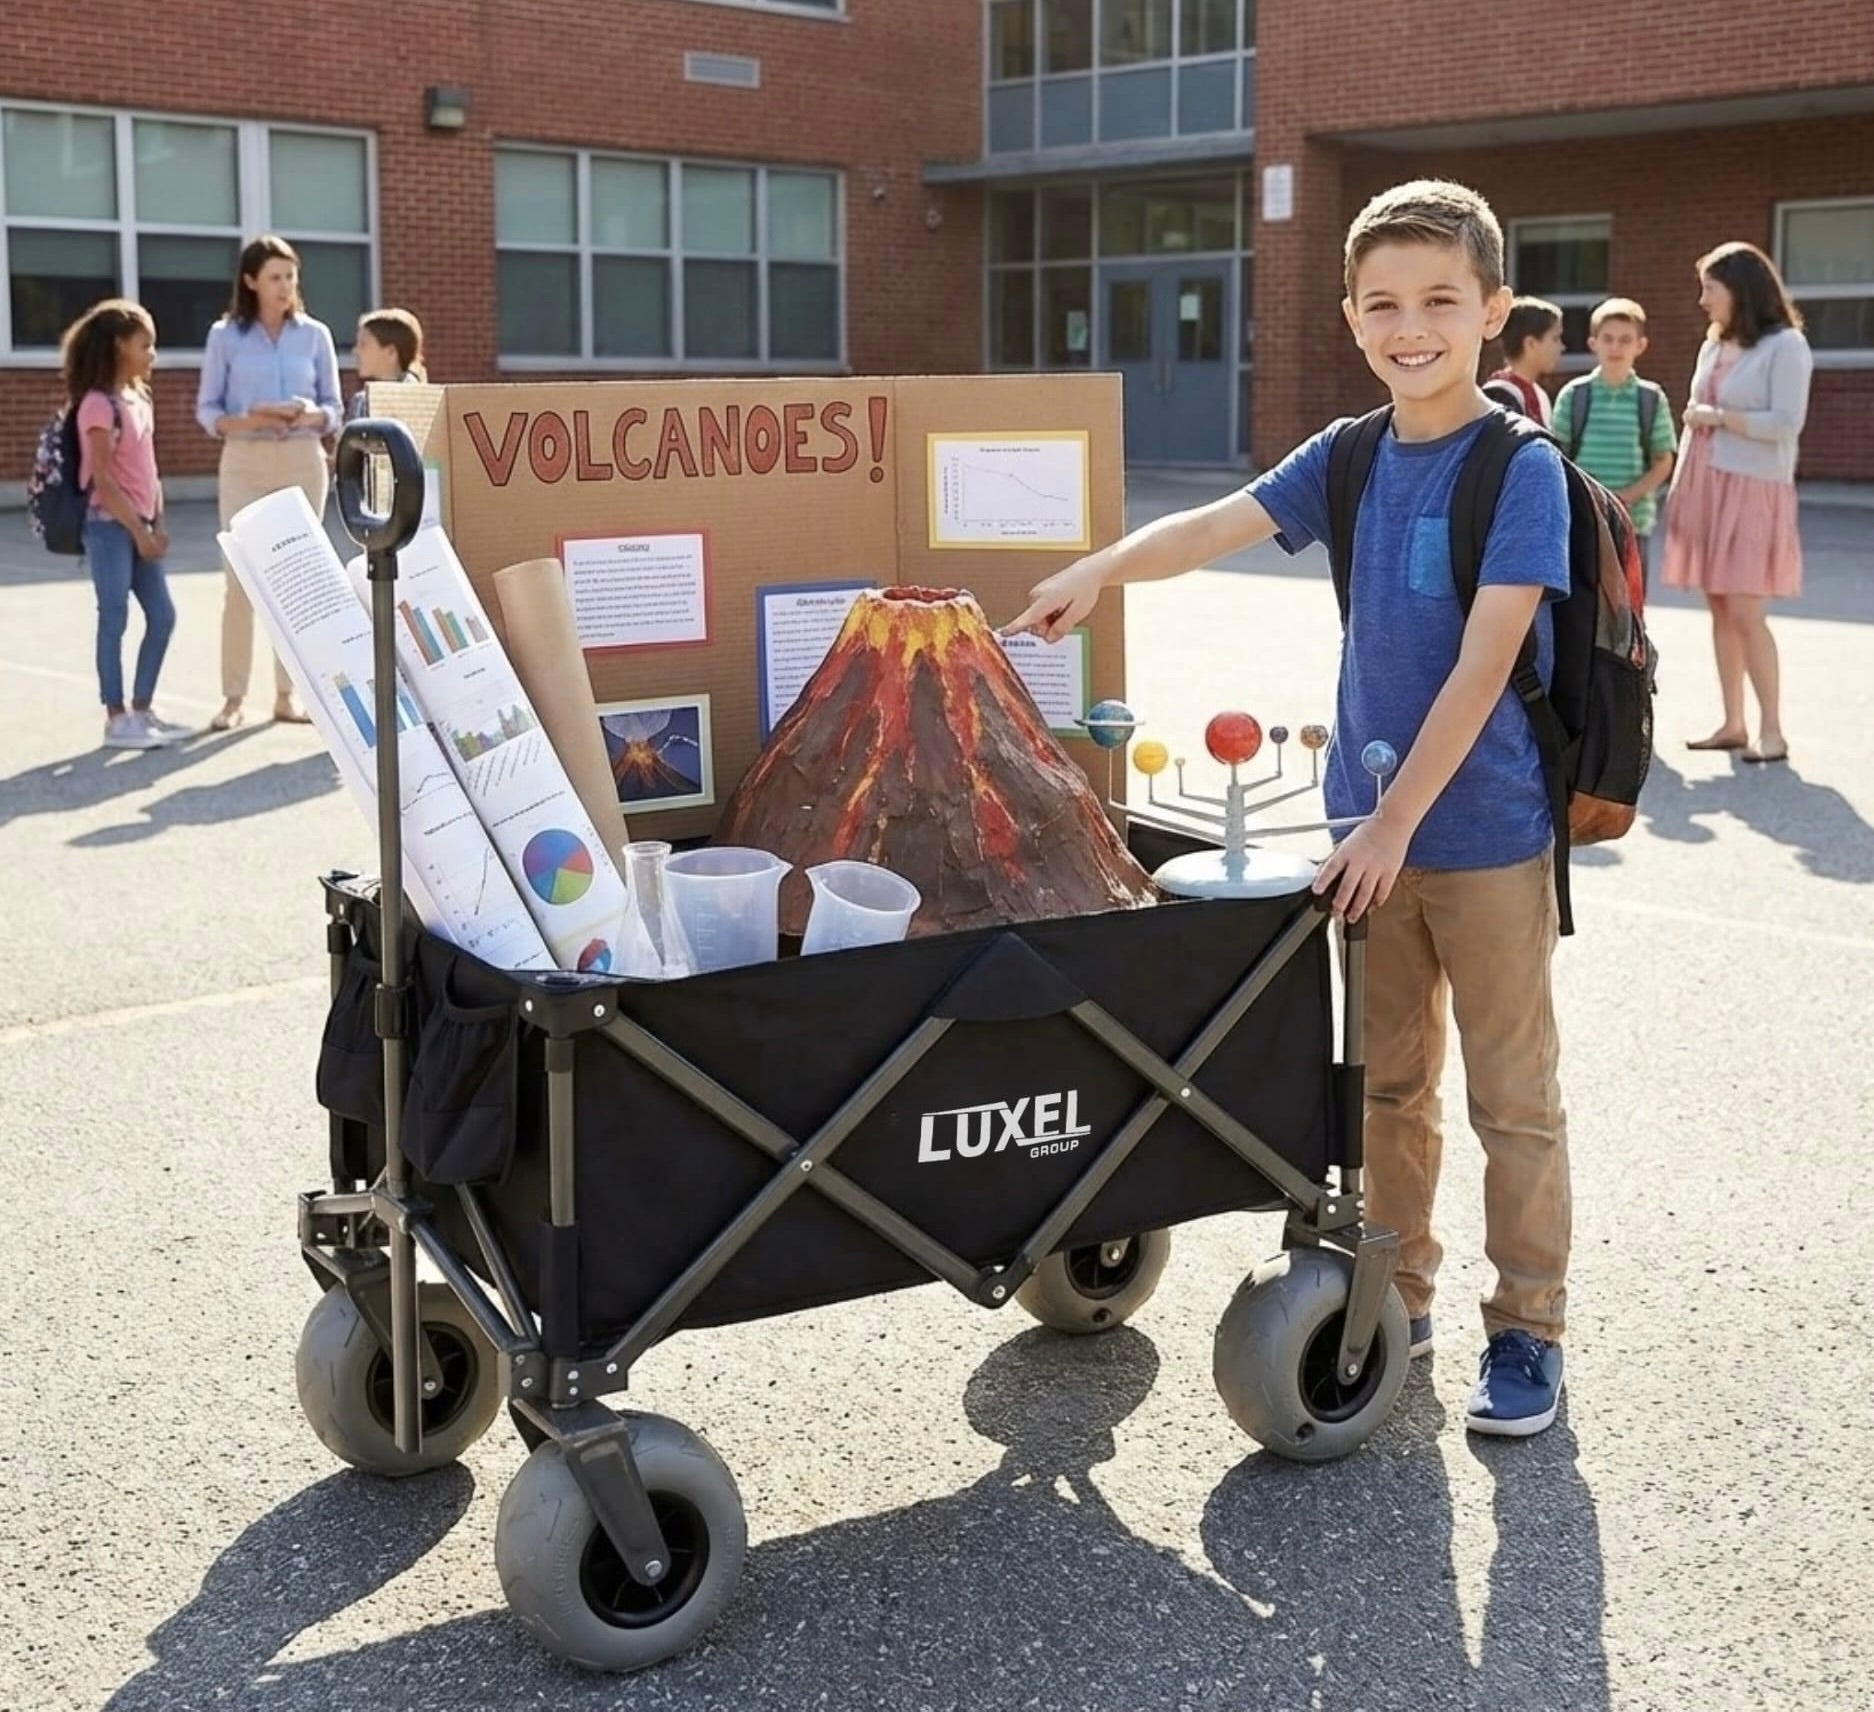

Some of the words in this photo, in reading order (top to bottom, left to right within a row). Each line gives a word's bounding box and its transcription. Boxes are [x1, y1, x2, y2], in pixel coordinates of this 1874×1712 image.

[463, 396, 888, 487] VOLCANOES!
[918, 1089, 1091, 1163] LUXEL
[1030, 1139, 1080, 1159] GROUP
